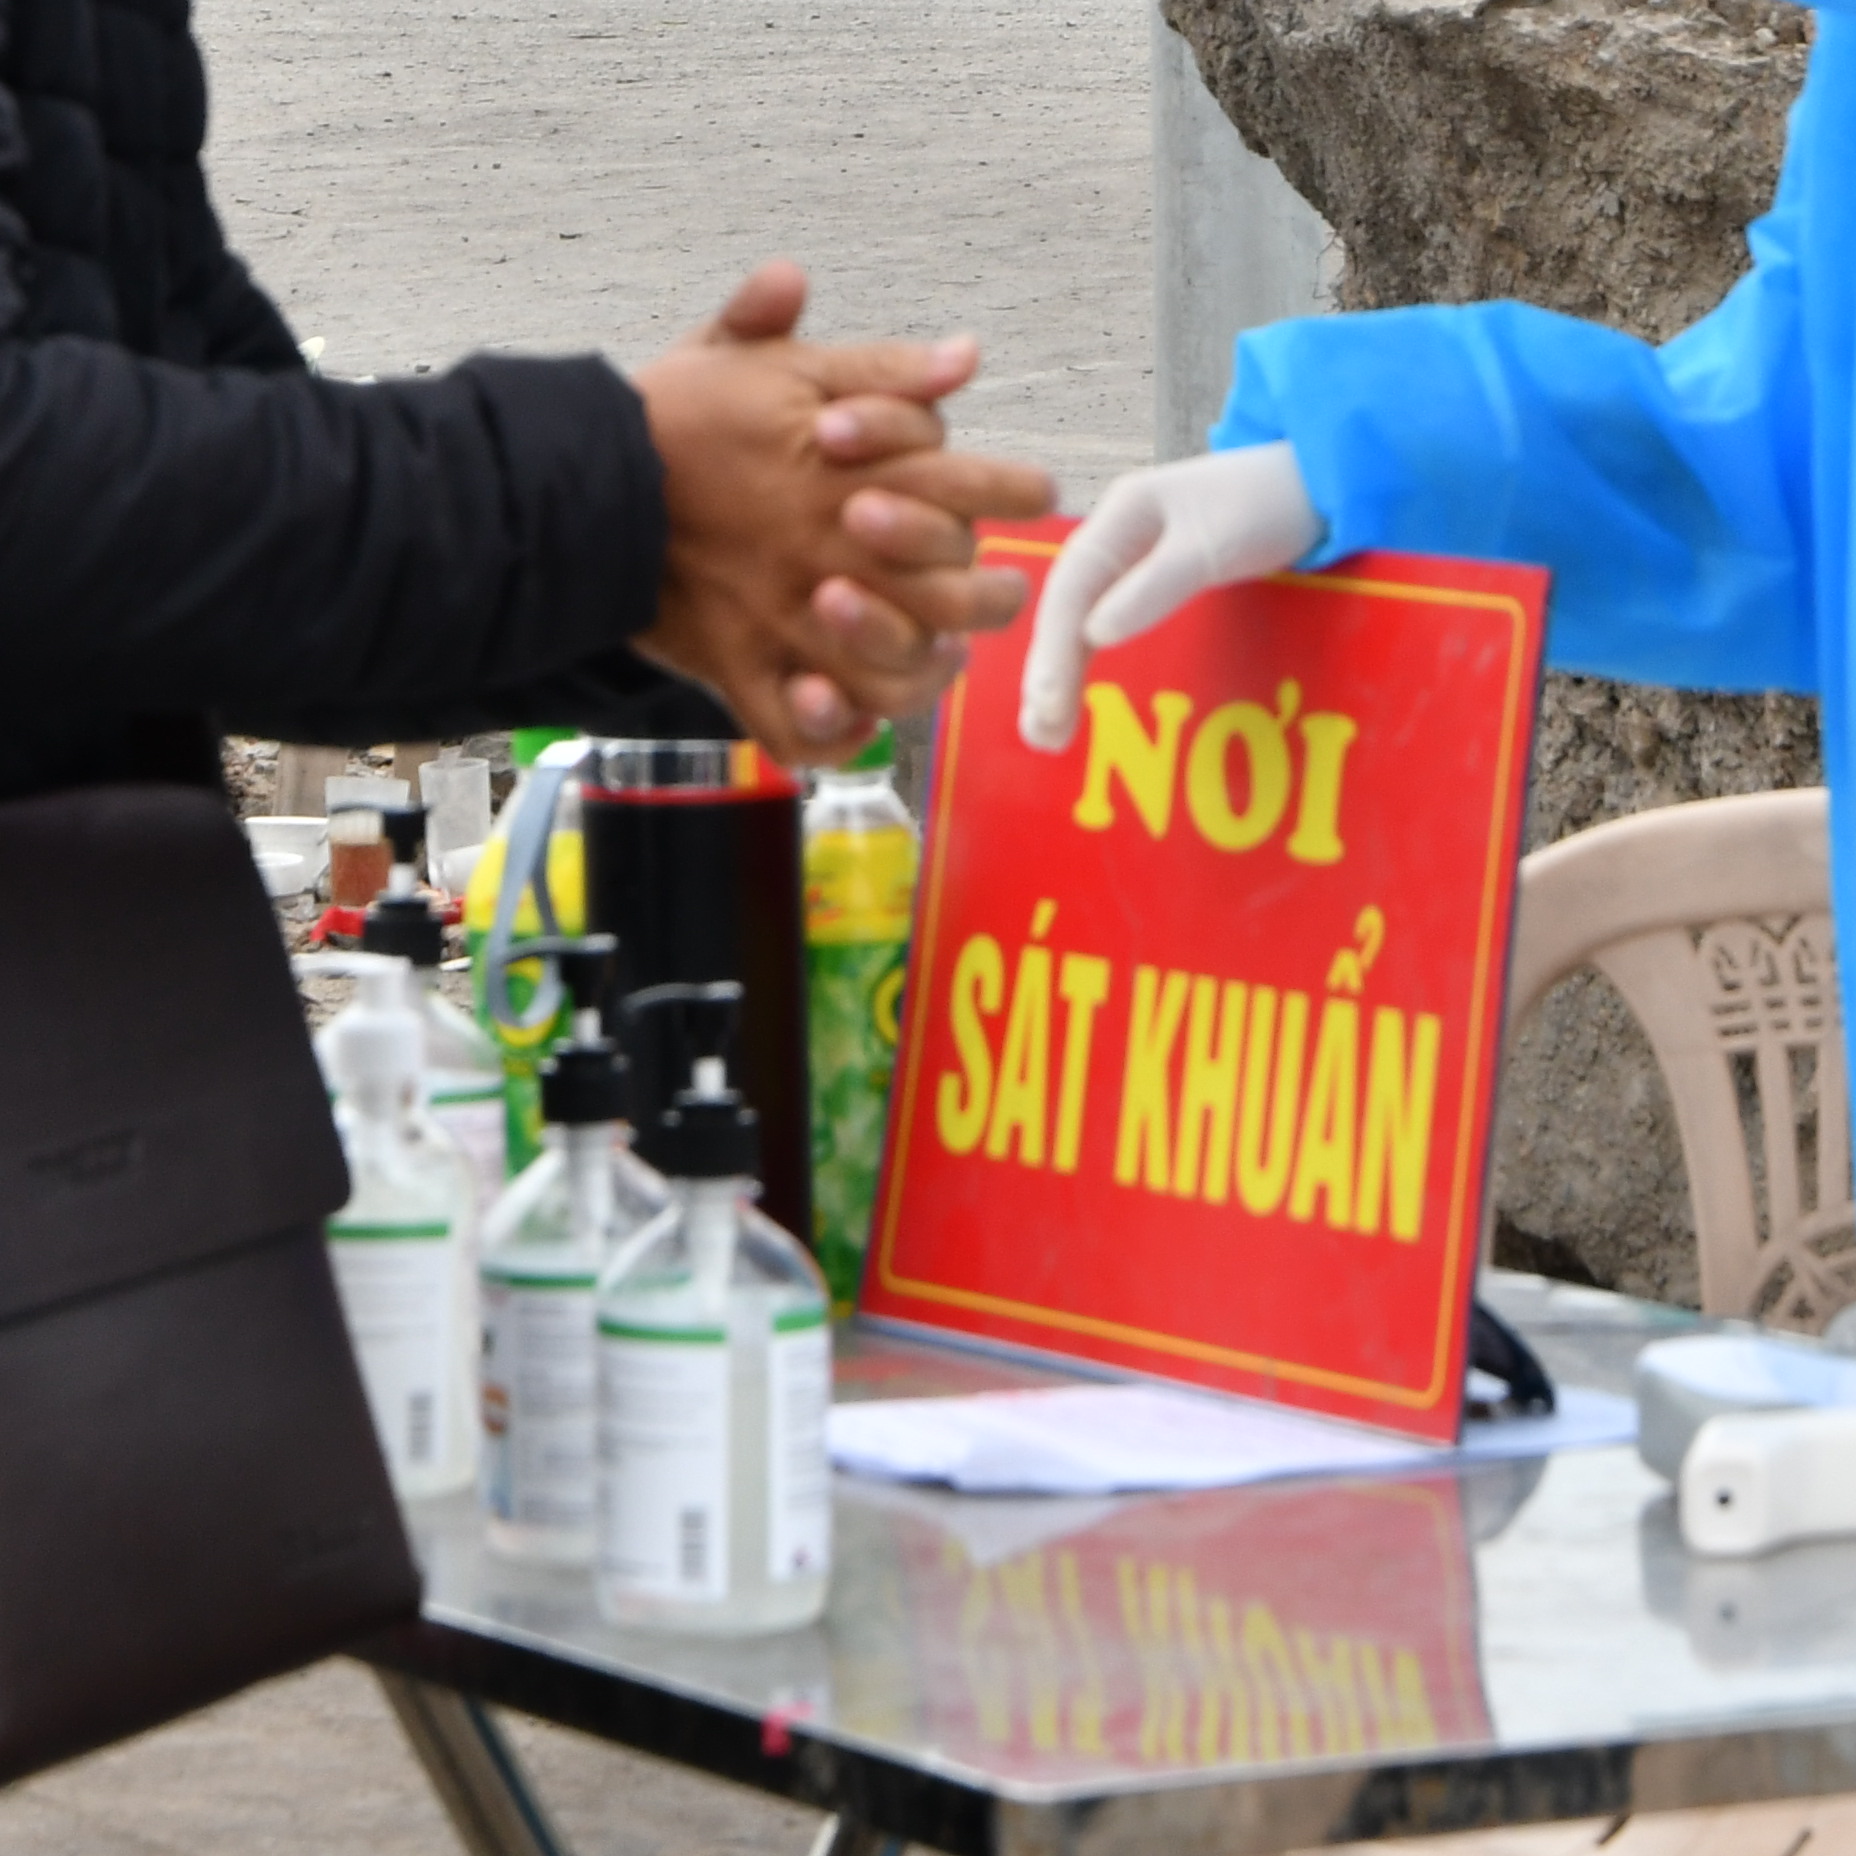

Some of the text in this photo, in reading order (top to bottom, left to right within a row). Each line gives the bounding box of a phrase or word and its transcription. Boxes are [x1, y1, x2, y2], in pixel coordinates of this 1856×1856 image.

[1073, 678, 1357, 866] NƠI
[935, 897, 1442, 1242] SÁT KHUẨN
